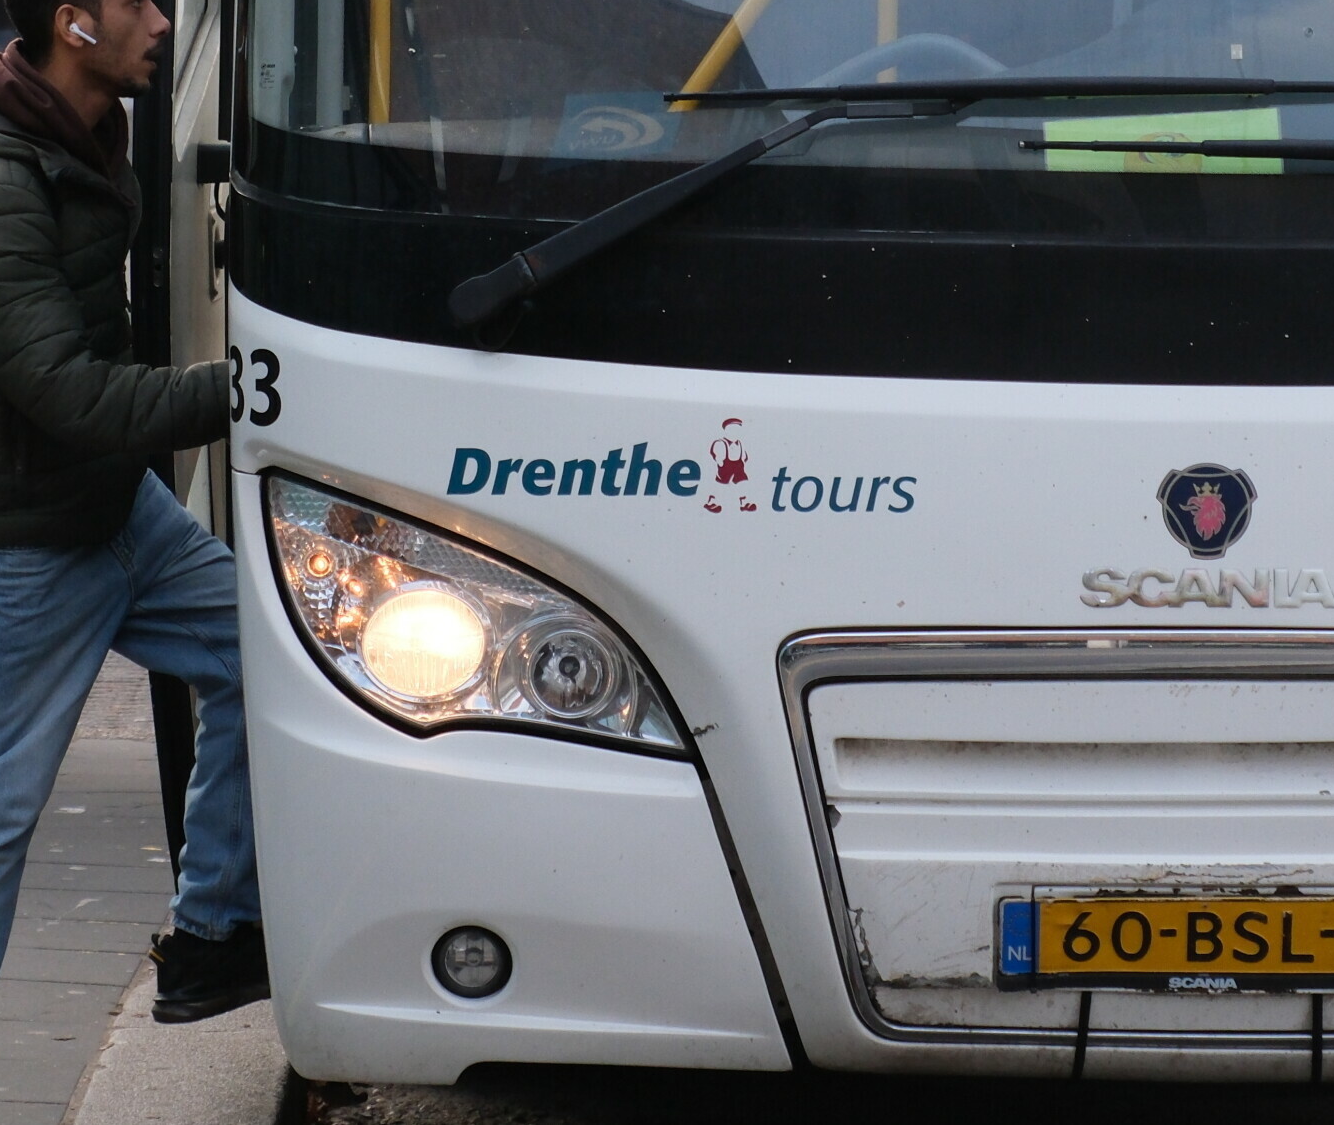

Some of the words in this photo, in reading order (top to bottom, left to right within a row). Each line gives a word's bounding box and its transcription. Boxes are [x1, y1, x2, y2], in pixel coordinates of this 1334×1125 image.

[446, 441, 702, 496] Drenthe
[770, 466, 917, 514] tours
[1007, 947, 1033, 962] NL
[1169, 977, 1238, 989] SCANIA
